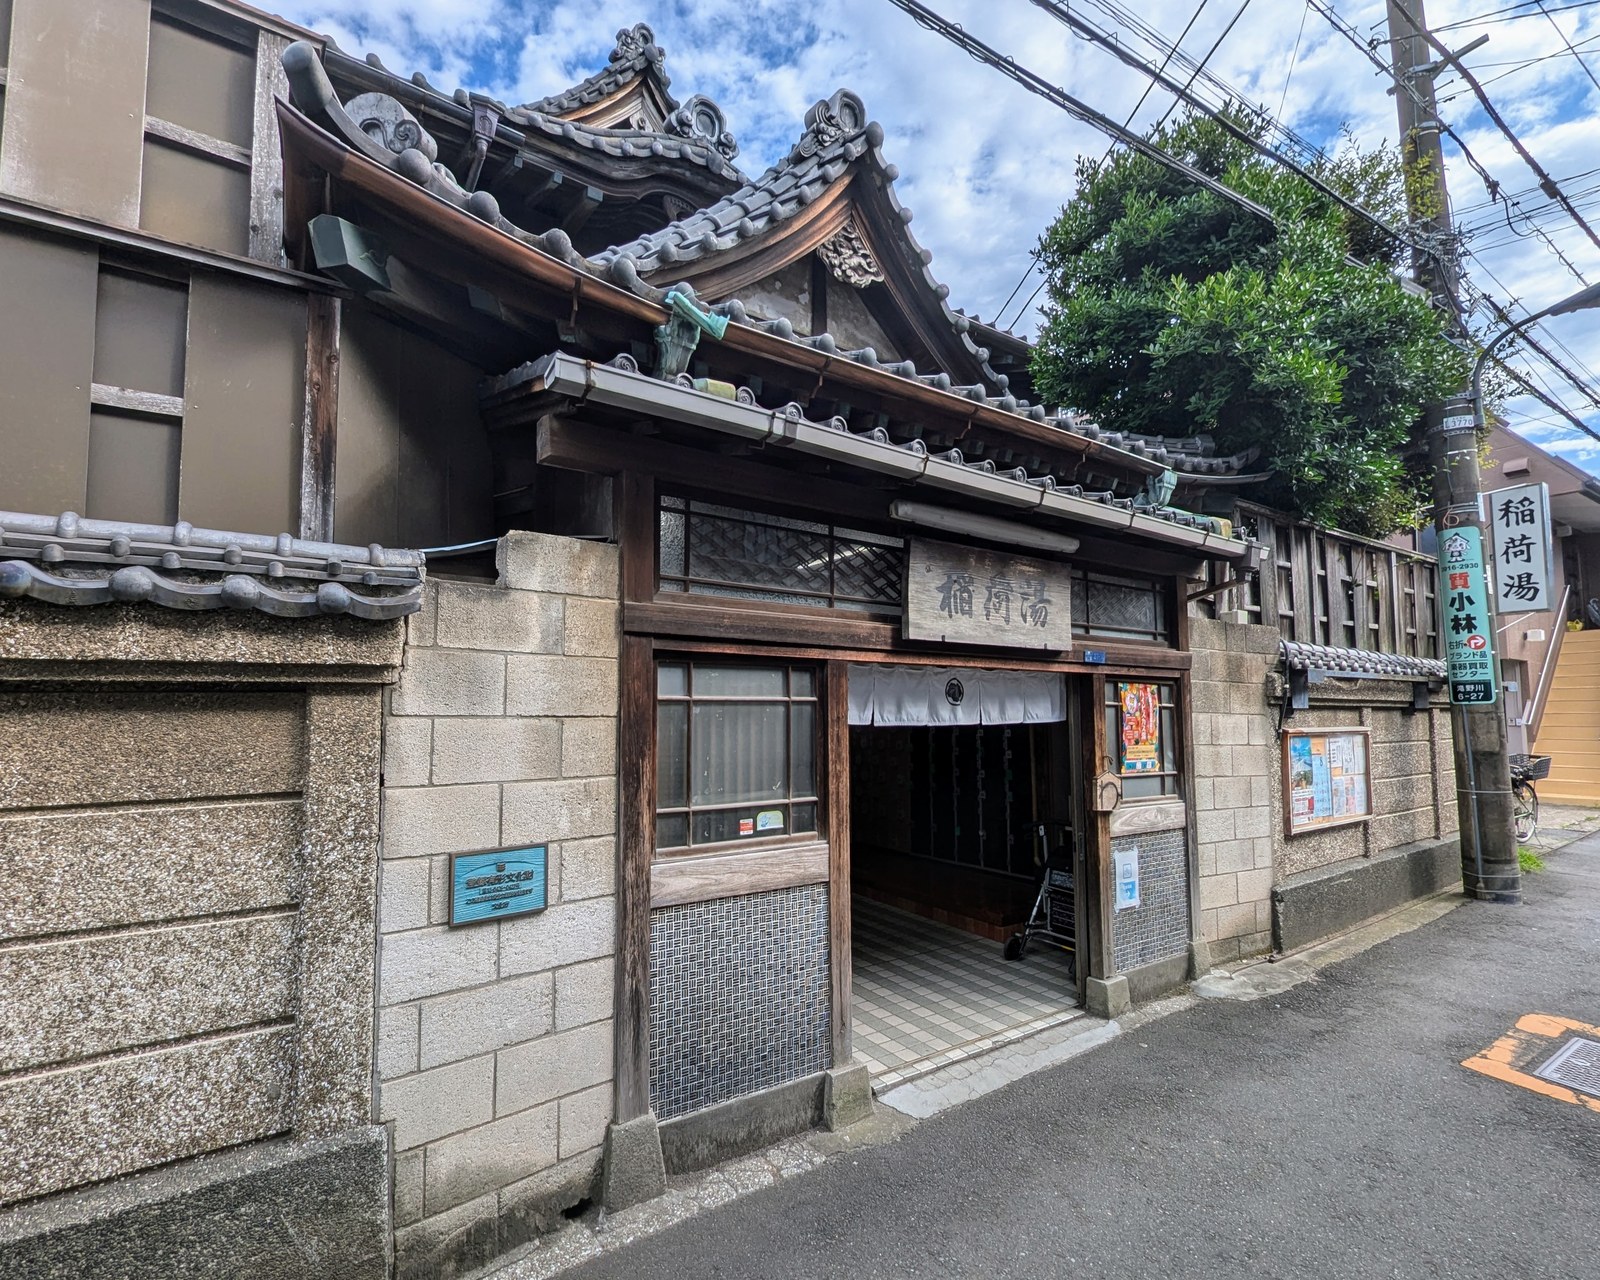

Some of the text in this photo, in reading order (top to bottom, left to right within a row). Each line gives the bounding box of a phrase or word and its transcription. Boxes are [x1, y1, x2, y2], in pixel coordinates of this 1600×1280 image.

[1451, 418, 1473, 428] 3770
[1498, 496, 1540, 602] 稲荷湯
[936, 571, 1052, 628] 稲荷湯
[1449, 650, 1488, 660] ブランド品
[1451, 670, 1489, 679] センター
[1456, 684, 1485, 692] 滝野川
[1457, 692, 1485, 701] 6-27
